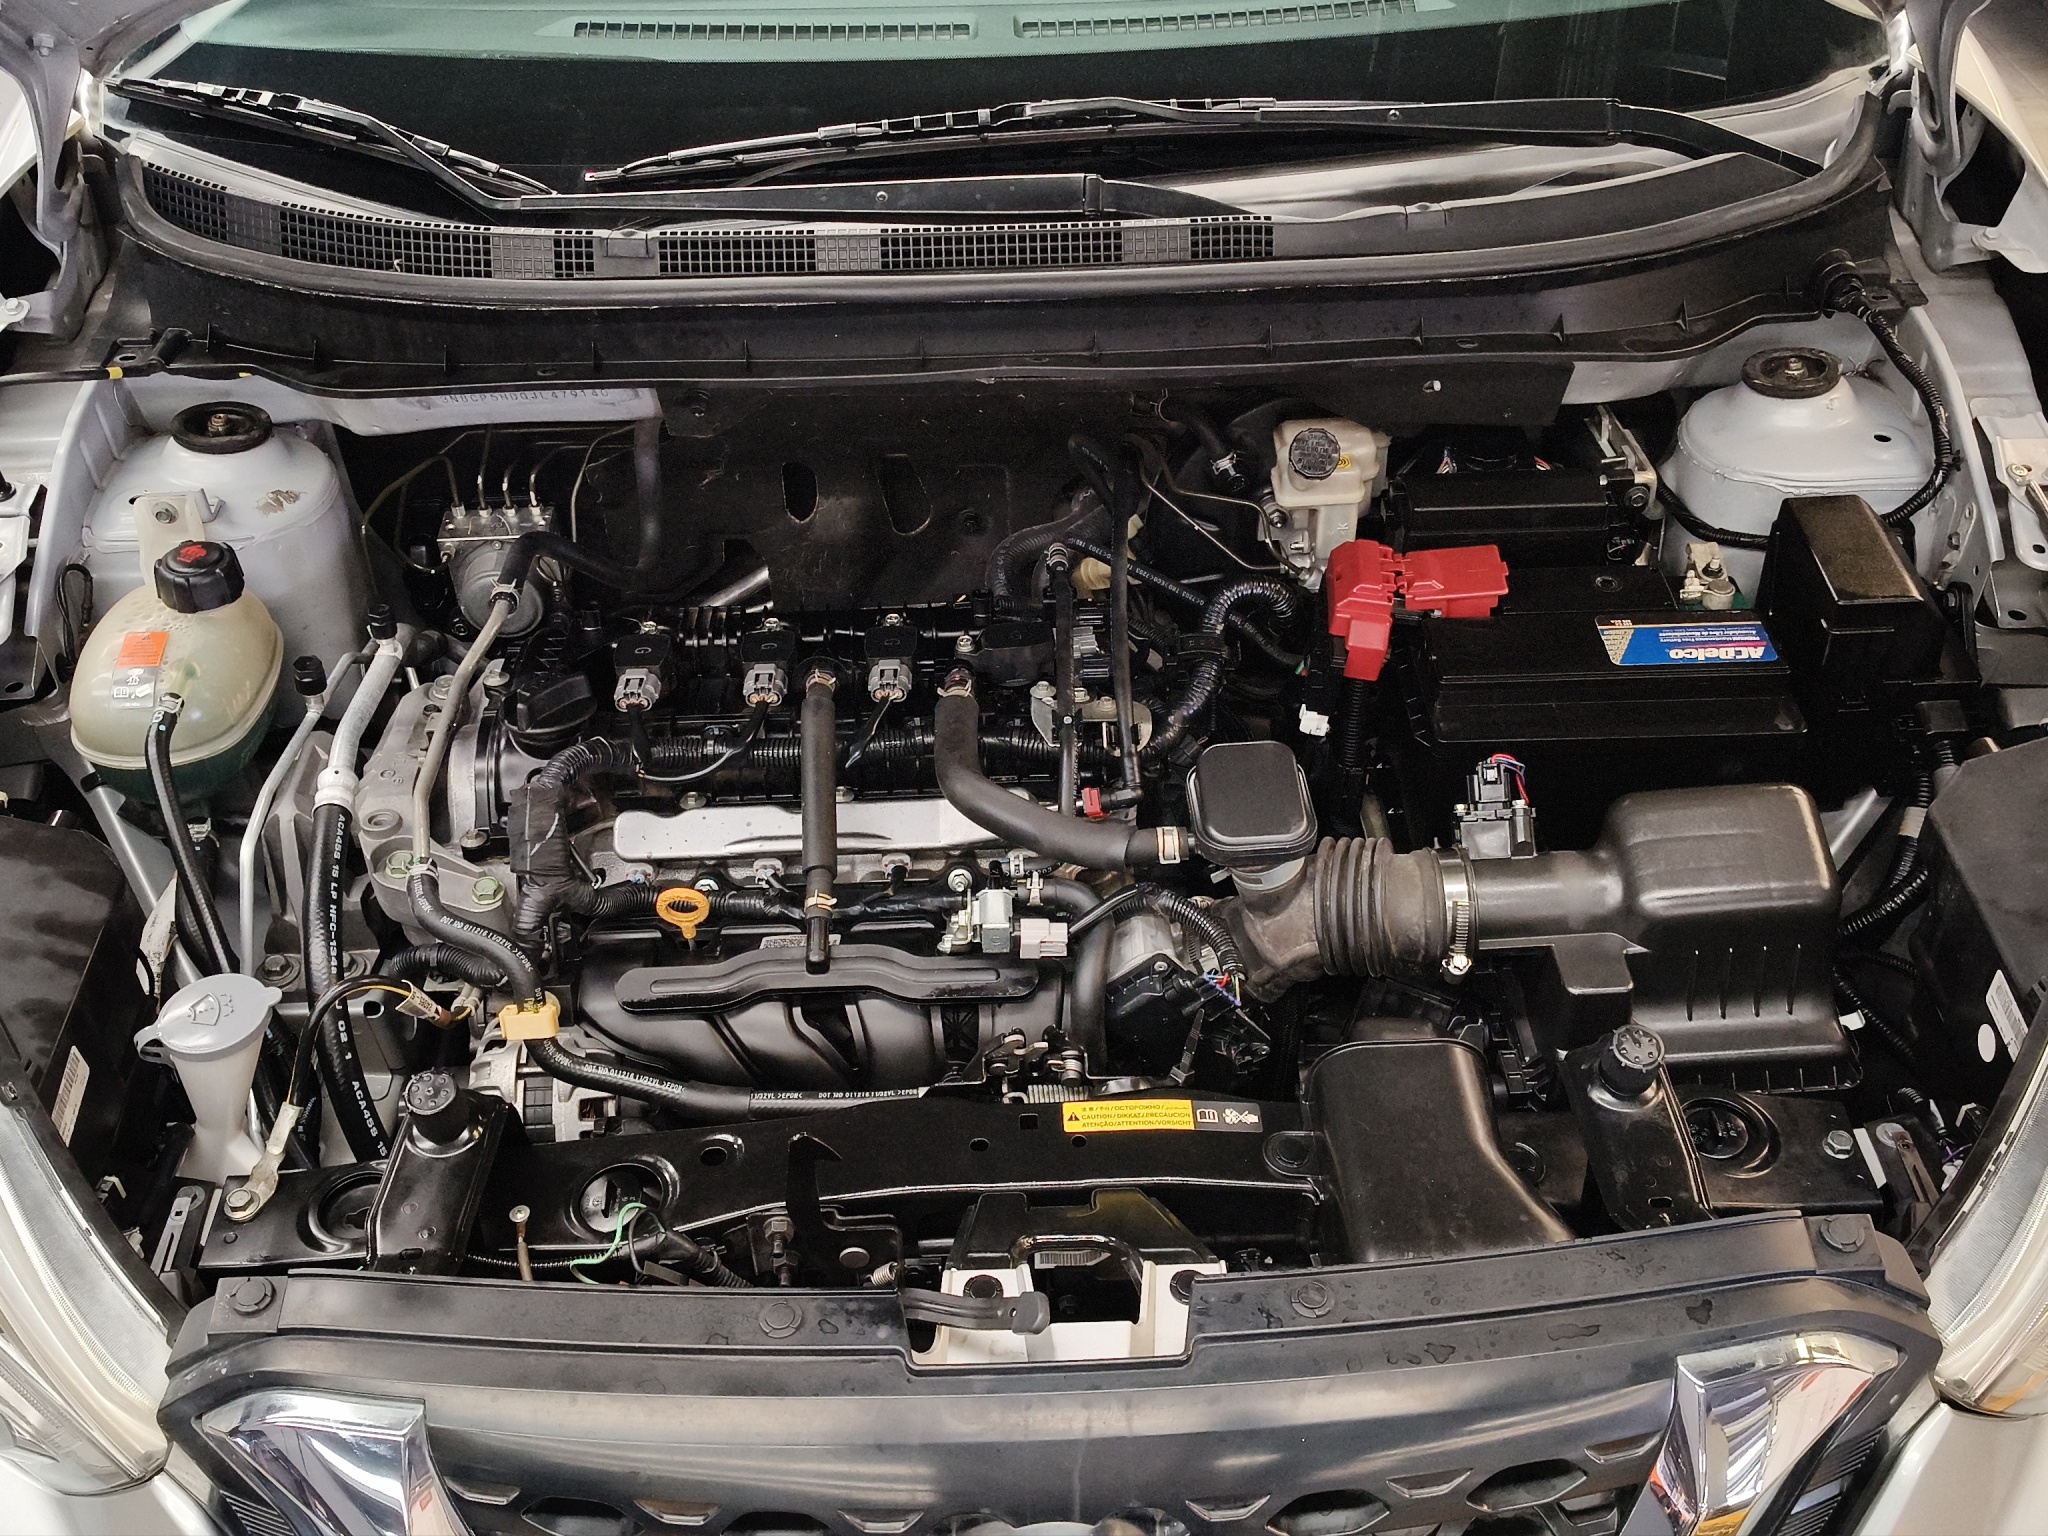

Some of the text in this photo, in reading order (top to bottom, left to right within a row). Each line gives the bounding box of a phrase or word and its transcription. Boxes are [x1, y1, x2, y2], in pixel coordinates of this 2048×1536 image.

[1668, 646, 1767, 661] ACDelco
[331, 864, 340, 878] 15
[330, 882, 339, 900] LP
[329, 904, 338, 975] HFC-134a
[376, 1141, 388, 1157] 15
